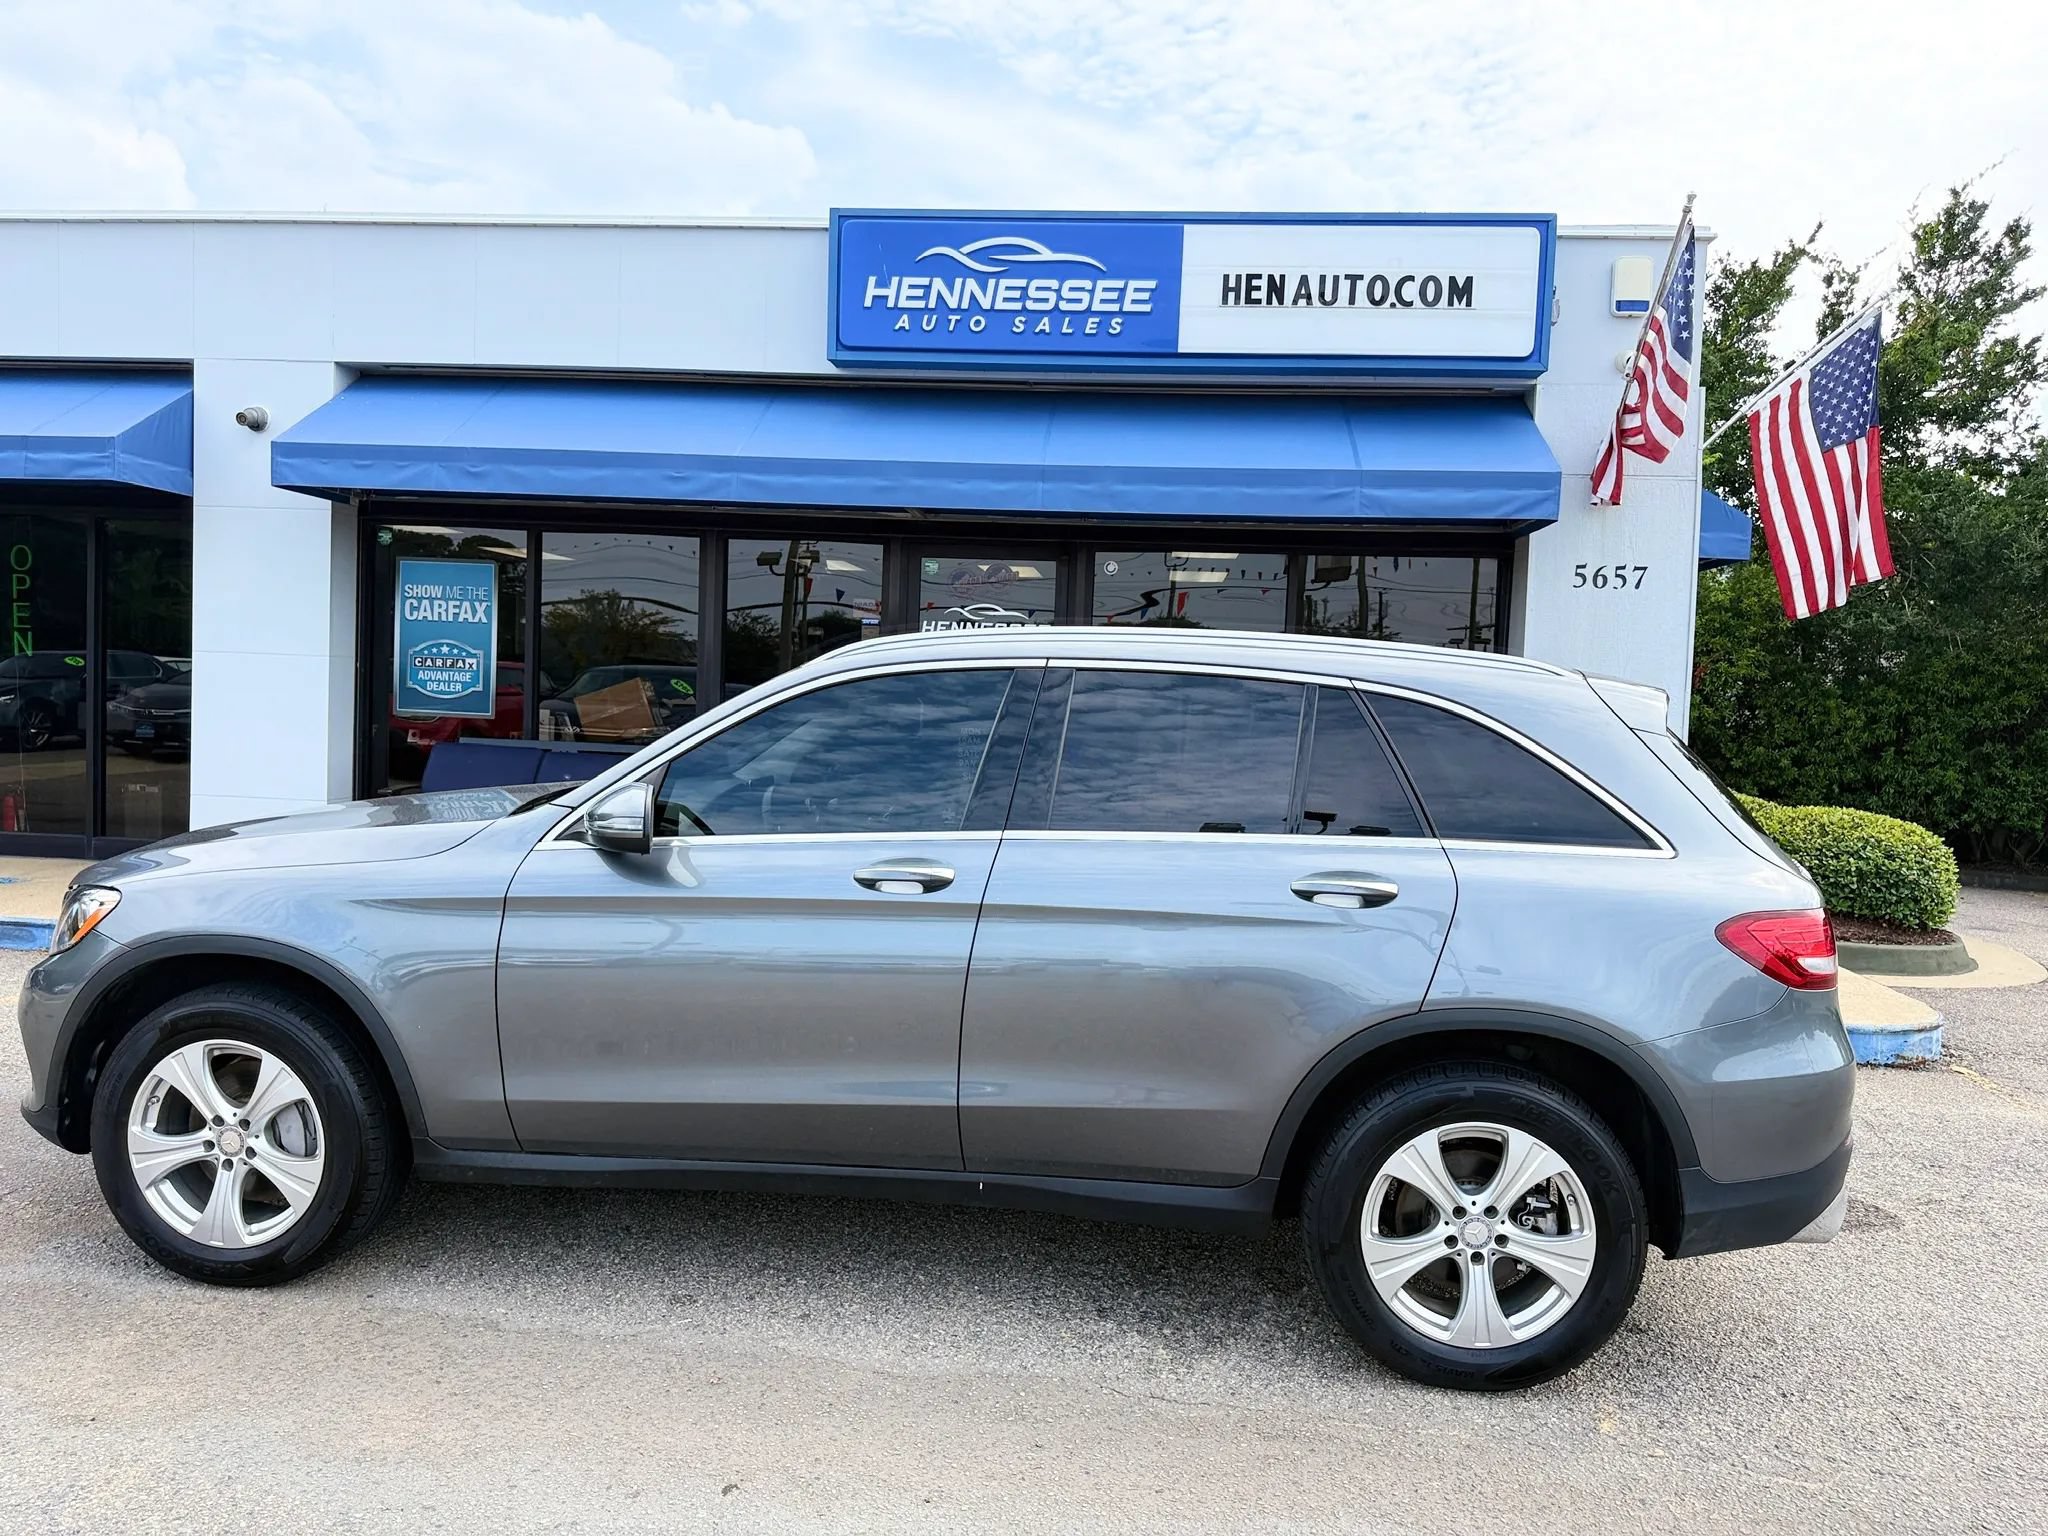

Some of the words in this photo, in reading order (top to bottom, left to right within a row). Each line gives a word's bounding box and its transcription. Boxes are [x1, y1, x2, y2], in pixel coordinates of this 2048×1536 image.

[863, 276, 1157, 312] HENNESSEE
[894, 314, 986, 332] AUTO
[1012, 316, 1124, 334] SALES
[1572, 563, 1648, 590] 5657
[10, 545, 33, 656] OPEN
[404, 583, 443, 598] SHOW
[445, 585, 464, 600] ME
[466, 586, 489, 600] THE
[404, 599, 488, 623] CARFAX
[414, 657, 476, 670] CARFAX
[418, 670, 472, 682] ADVANTAGE
[426, 681, 462, 692] DEALER
